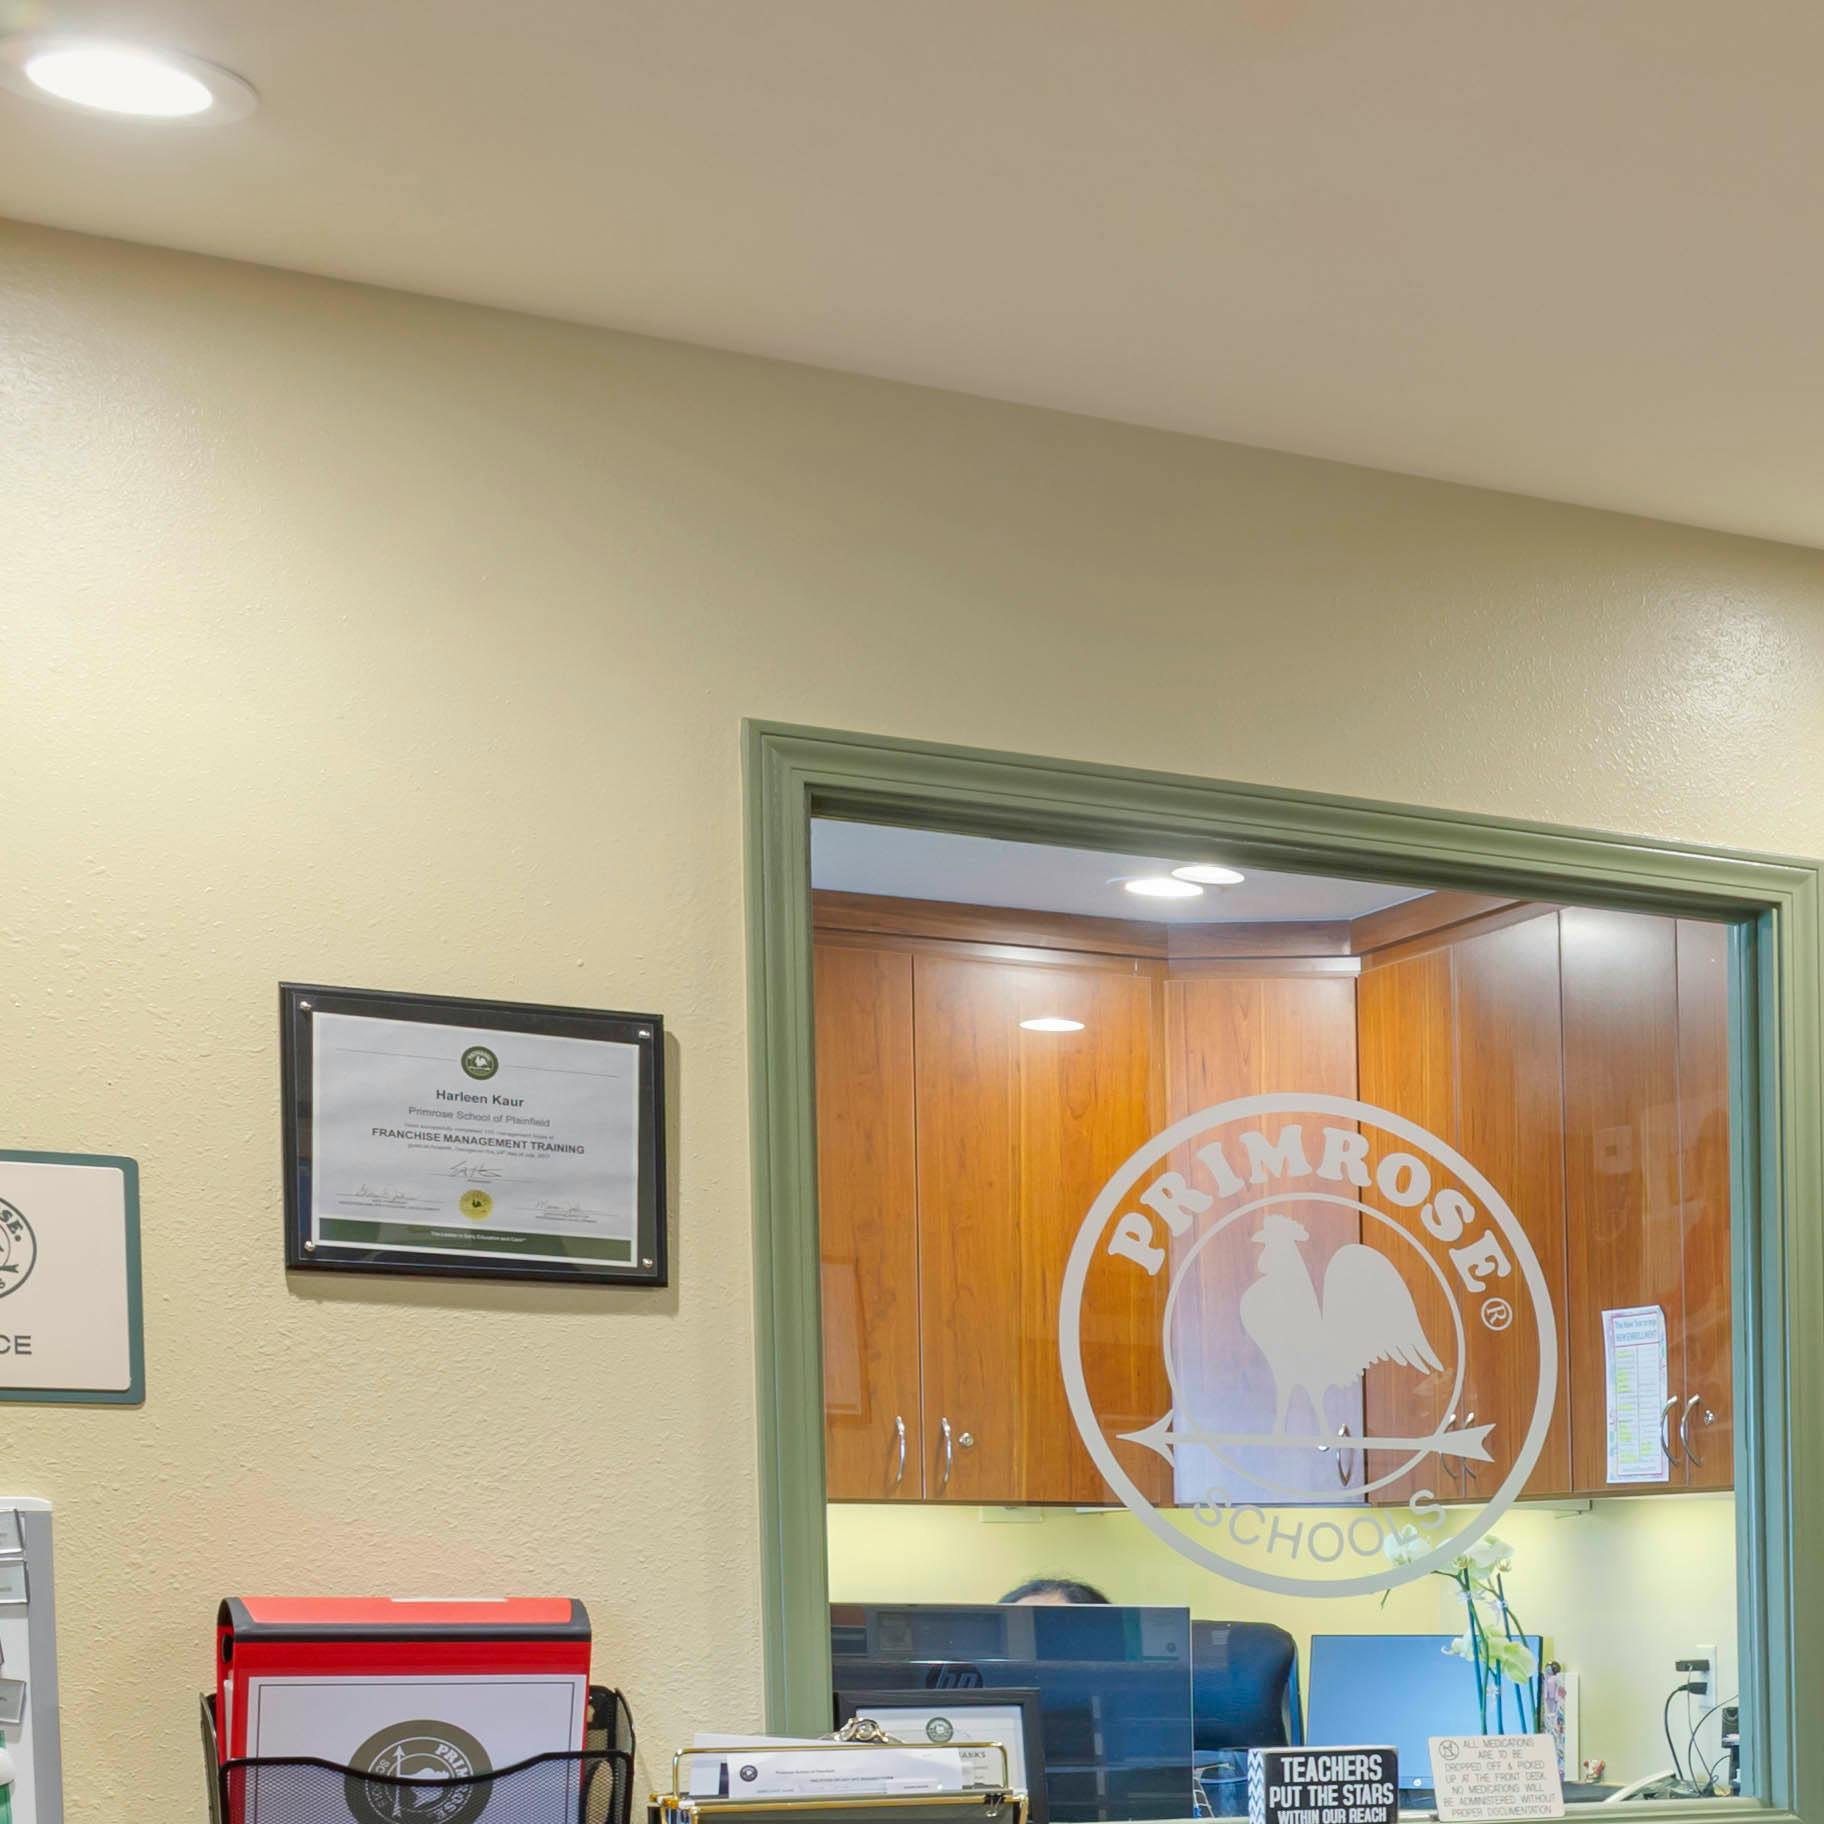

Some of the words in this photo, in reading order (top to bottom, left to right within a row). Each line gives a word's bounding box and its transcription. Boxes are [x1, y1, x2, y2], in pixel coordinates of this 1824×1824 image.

[436, 1089, 488, 1105] Harleen
[492, 1094, 524, 1108] Kaur
[408, 1106, 453, 1119] Primrose
[456, 1110, 491, 1122] School
[493, 1112, 503, 1123] of
[505, 1115, 551, 1128] Plainfield
[371, 1127, 441, 1142] FRANCHISE
[443, 1133, 528, 1150] MANAGEMENT
[531, 1141, 585, 1155] TRAINING
[1193, 1484, 1447, 1563] SCHOOLS
[1463, 1739, 1480, 1749] ALL
[1482, 1738, 1535, 1748] MEDICATIONS
[1478, 1751, 1493, 1759] ARE
[1498, 1751, 1507, 1759] TO
[1512, 1749, 1524, 1759] BE
[1281, 1754, 1382, 1783] TEACHERS
[1444, 1762, 1481, 1772] DROPPED
[1487, 1762, 1501, 1771] OFF
[1517, 1760, 1545, 1770] PICKED
[1445, 1774, 1456, 1784] UP
[1461, 1774, 1470, 1783] AT
[1476, 1773, 1491, 1782] THE
[1495, 1772, 1520, 1782] FRONT
[1269, 1785, 1302, 1808] PUT
[1307, 1784, 1338, 1807] THE
[1342, 1782, 1394, 1806] STARS
[1451, 1786, 1464, 1795] NO
[1468, 1784, 1520, 1794] MEDICATIONS
[1525, 1783, 1545, 1793] WILL
[1443, 1797, 1455, 1807] BE
[1460, 1795, 1516, 1806] ADMINISTERED
[1521, 1793, 1556, 1803] WITHOUT
[1322, 1808, 1346, 1824] OUR
[1348, 1807, 1387, 1823] REACH
[1451, 1808, 1483, 1818] PROPER
